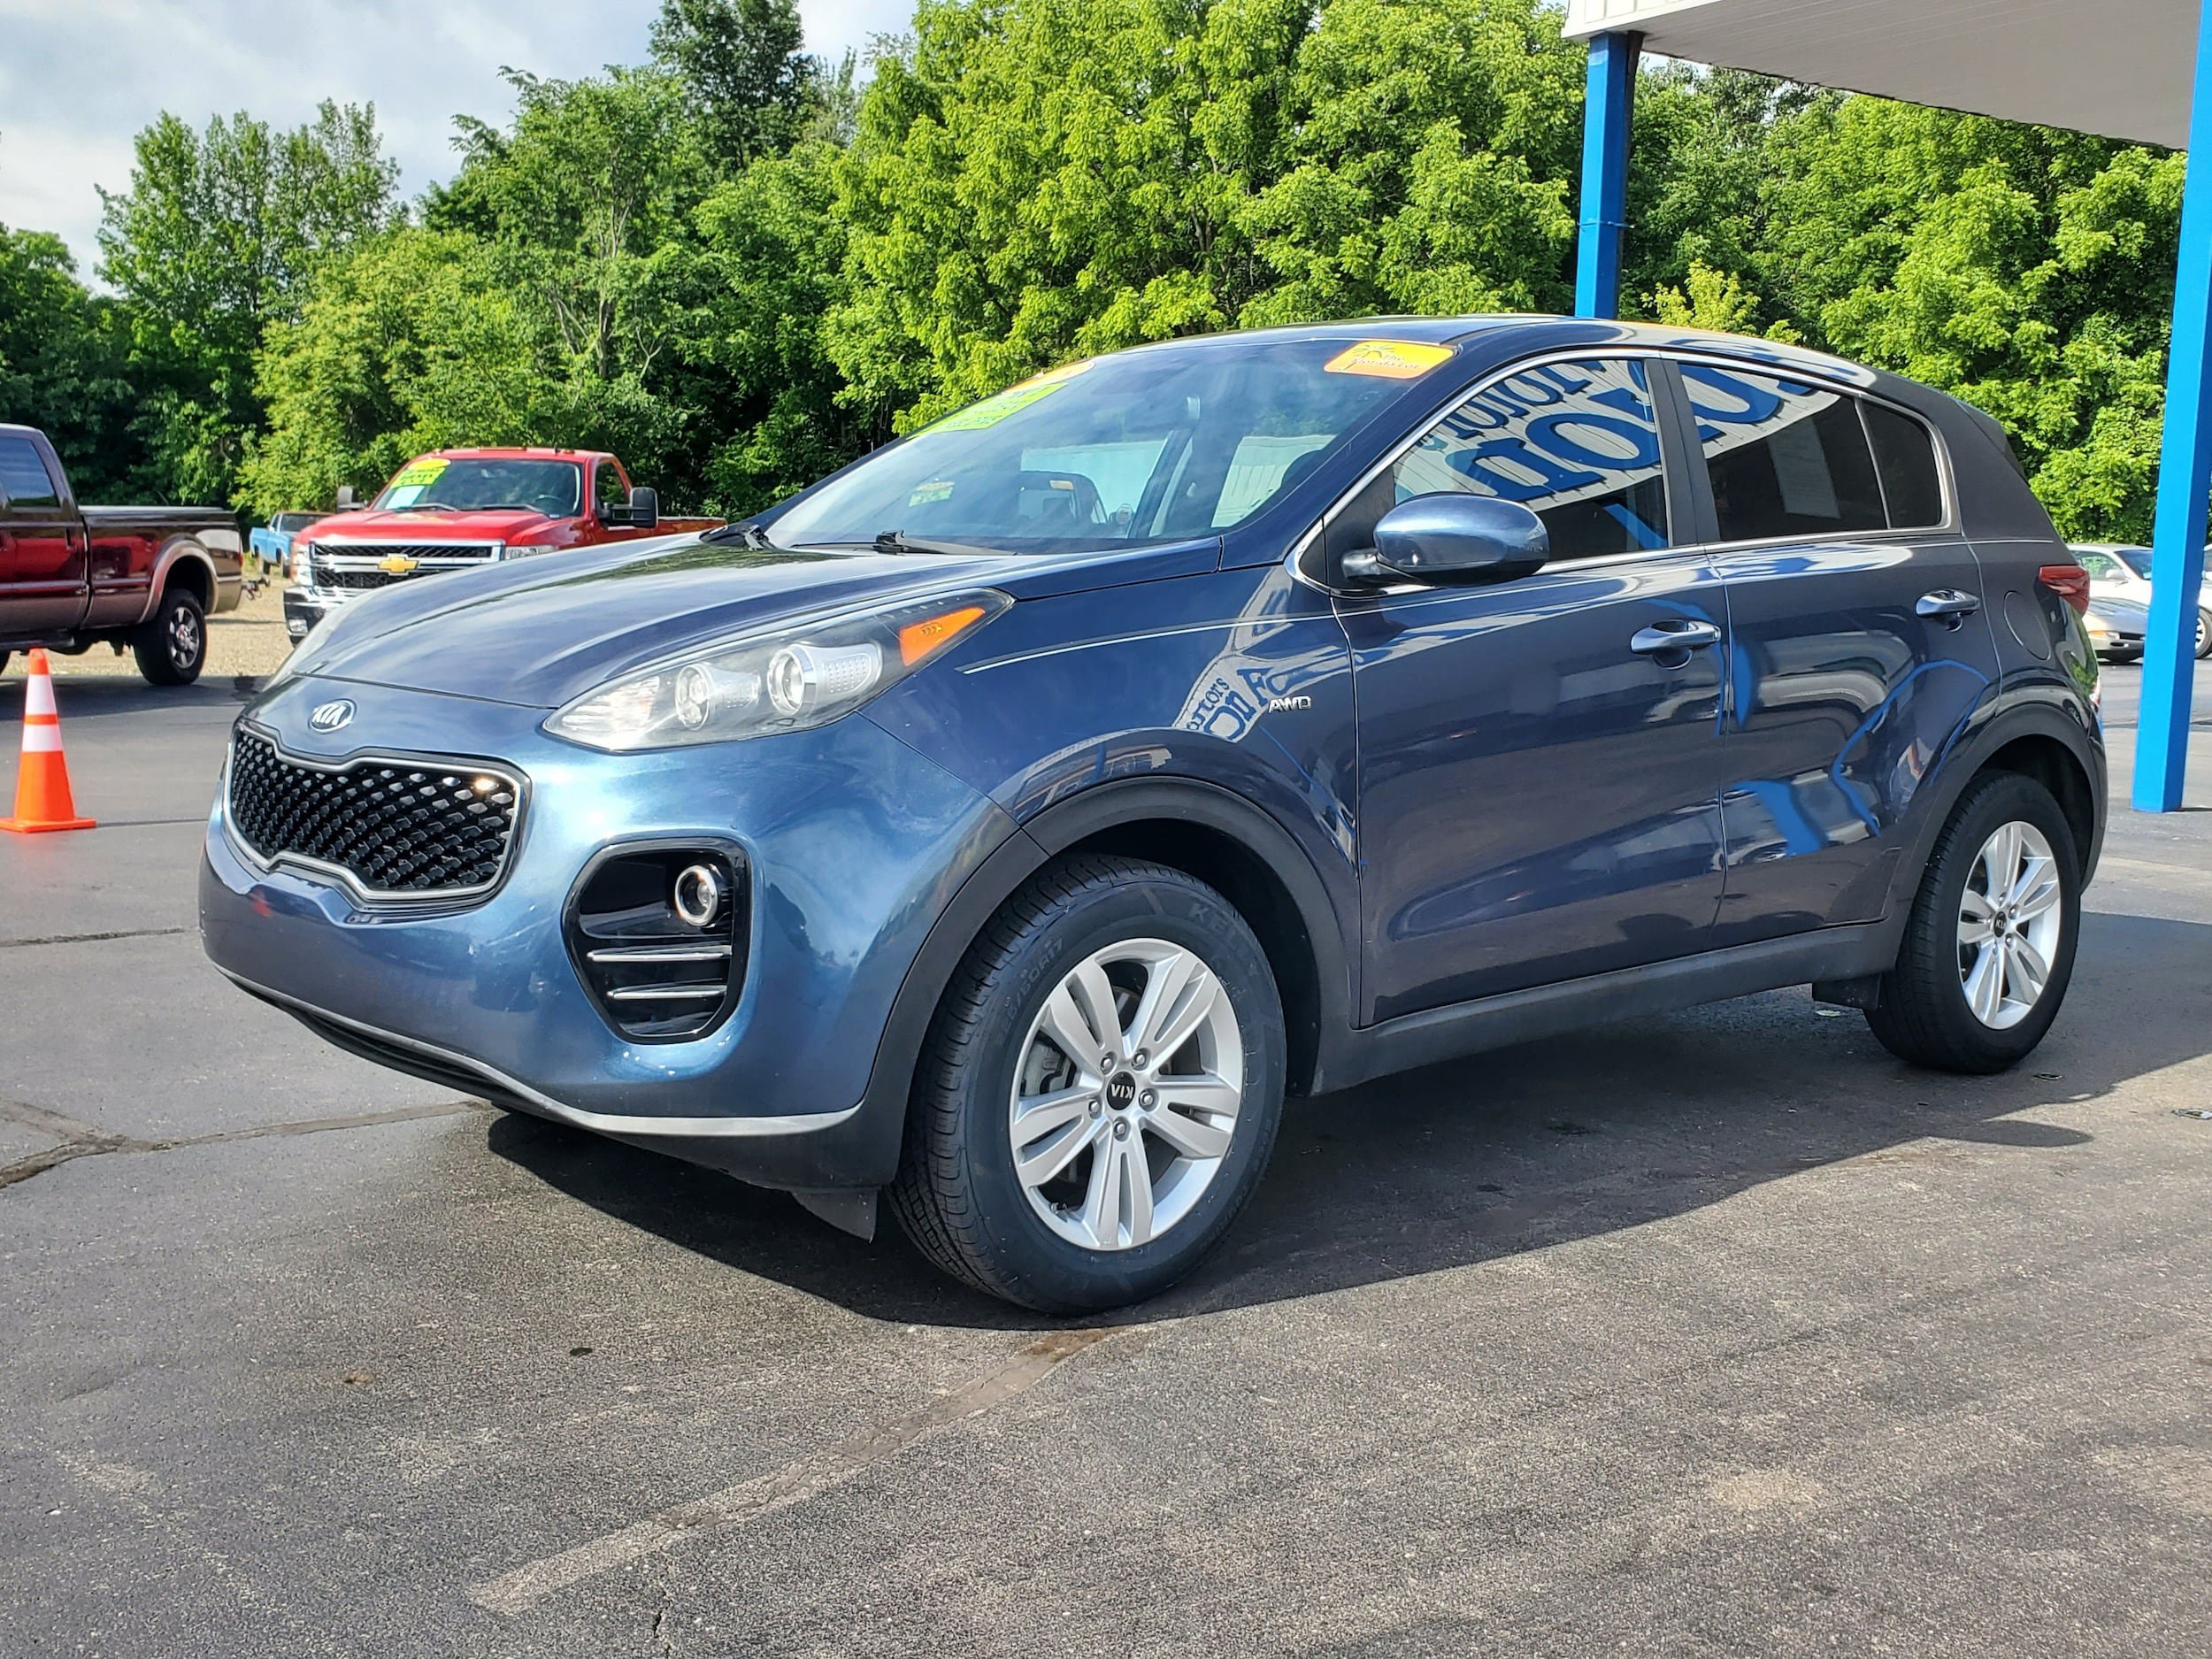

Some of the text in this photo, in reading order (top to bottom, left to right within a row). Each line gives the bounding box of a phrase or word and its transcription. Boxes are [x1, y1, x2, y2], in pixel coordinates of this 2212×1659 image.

[1268, 695, 1311, 713] AWD
[311, 704, 346, 726] KIA
[1111, 1084, 1133, 1099] KIA
